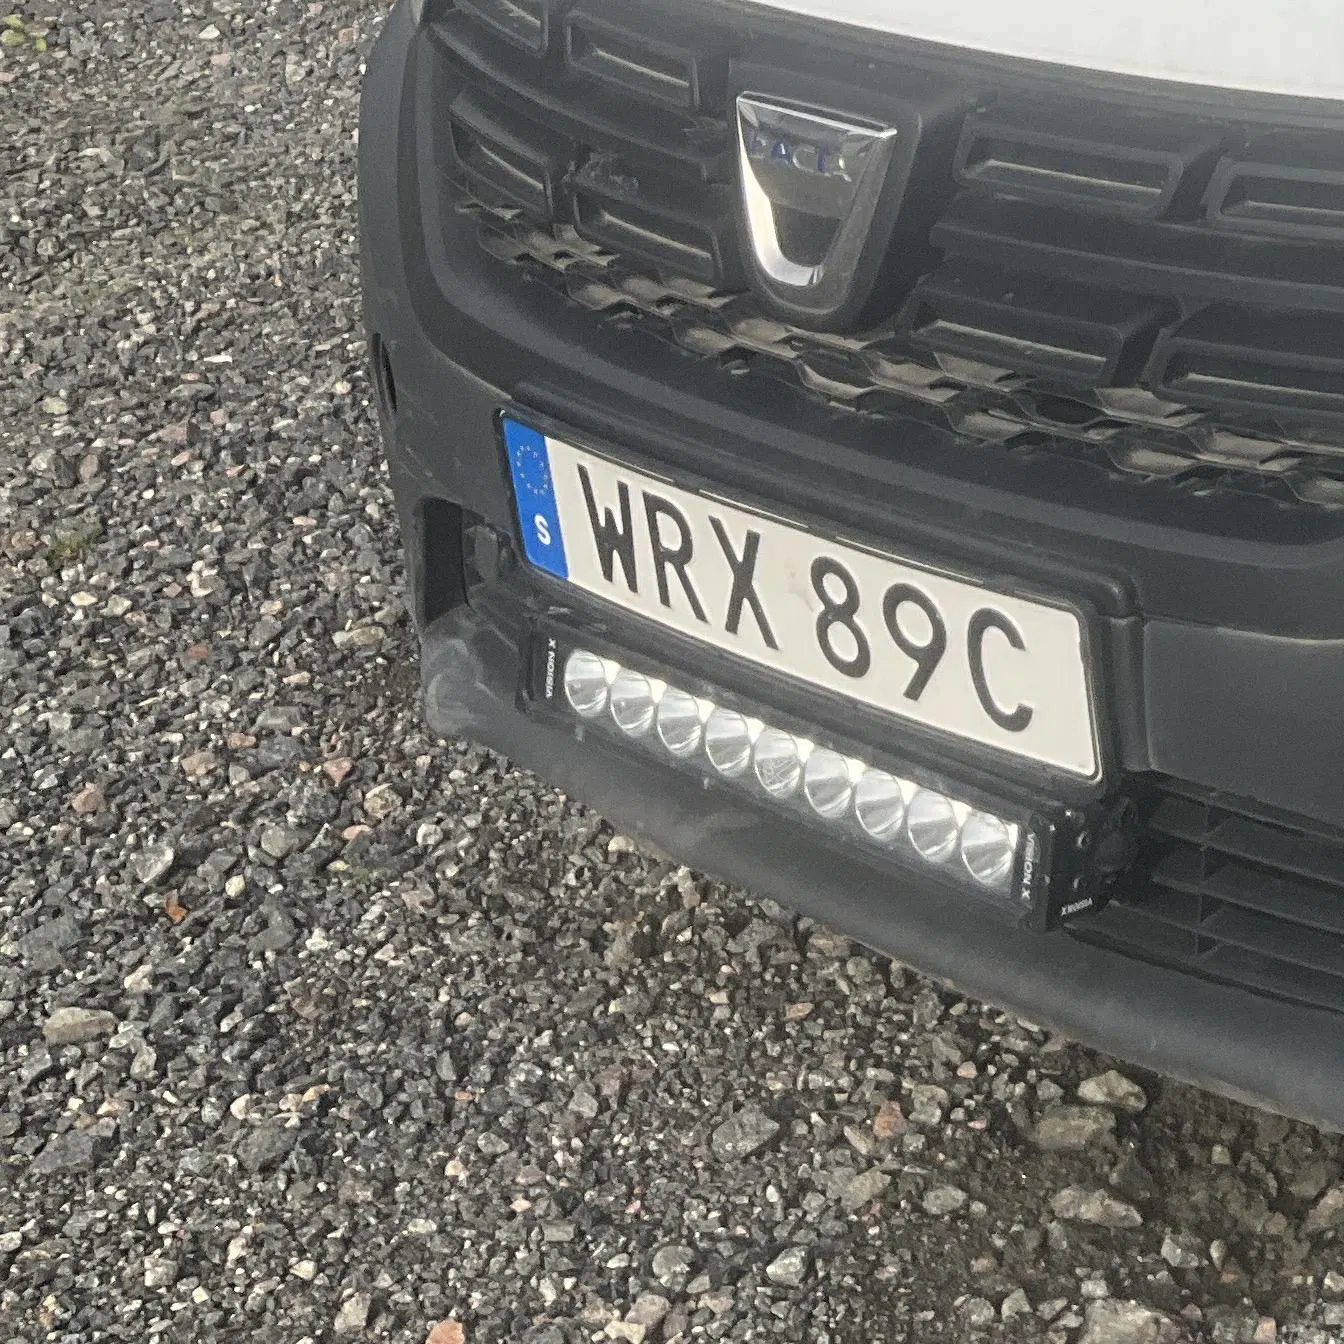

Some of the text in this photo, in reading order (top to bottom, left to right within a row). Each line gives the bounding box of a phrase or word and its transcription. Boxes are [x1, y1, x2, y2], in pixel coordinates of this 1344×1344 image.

[534, 514, 552, 547] S
[577, 463, 1034, 733] WRX 89C
